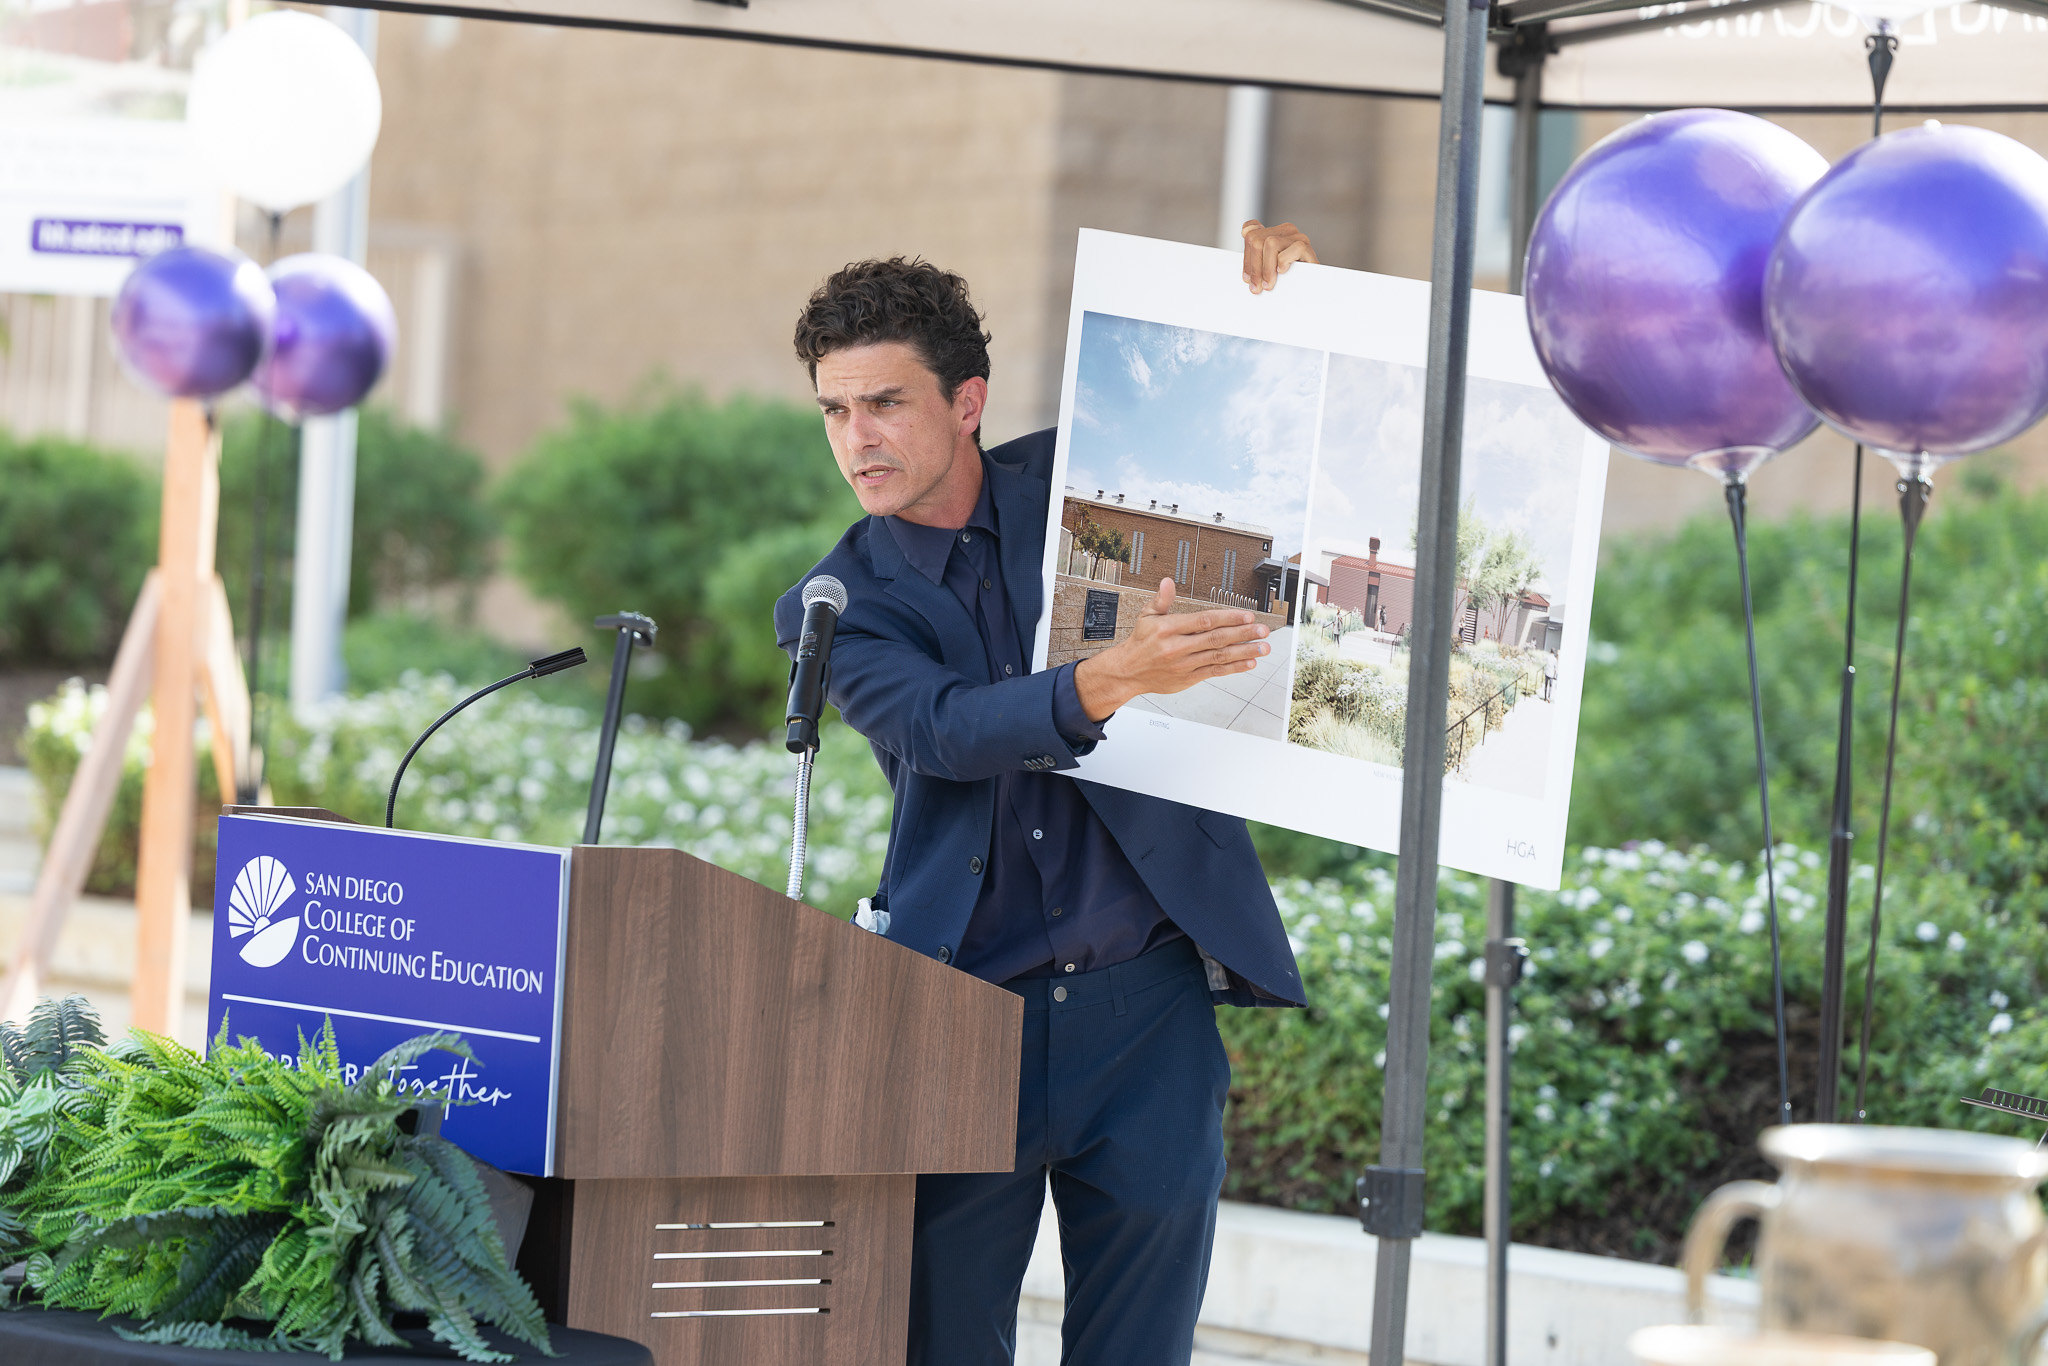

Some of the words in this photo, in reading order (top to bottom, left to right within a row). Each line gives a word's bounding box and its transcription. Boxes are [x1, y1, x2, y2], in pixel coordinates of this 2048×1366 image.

[1506, 838, 1537, 861] HGA
[305, 872, 340, 897] SAN
[345, 877, 403, 905] DIEGO
[304, 900, 386, 938] COLLEGE
[390, 918, 416, 941] OF
[302, 935, 426, 978] CONTINUING
[431, 951, 543, 994] EDUCATION
